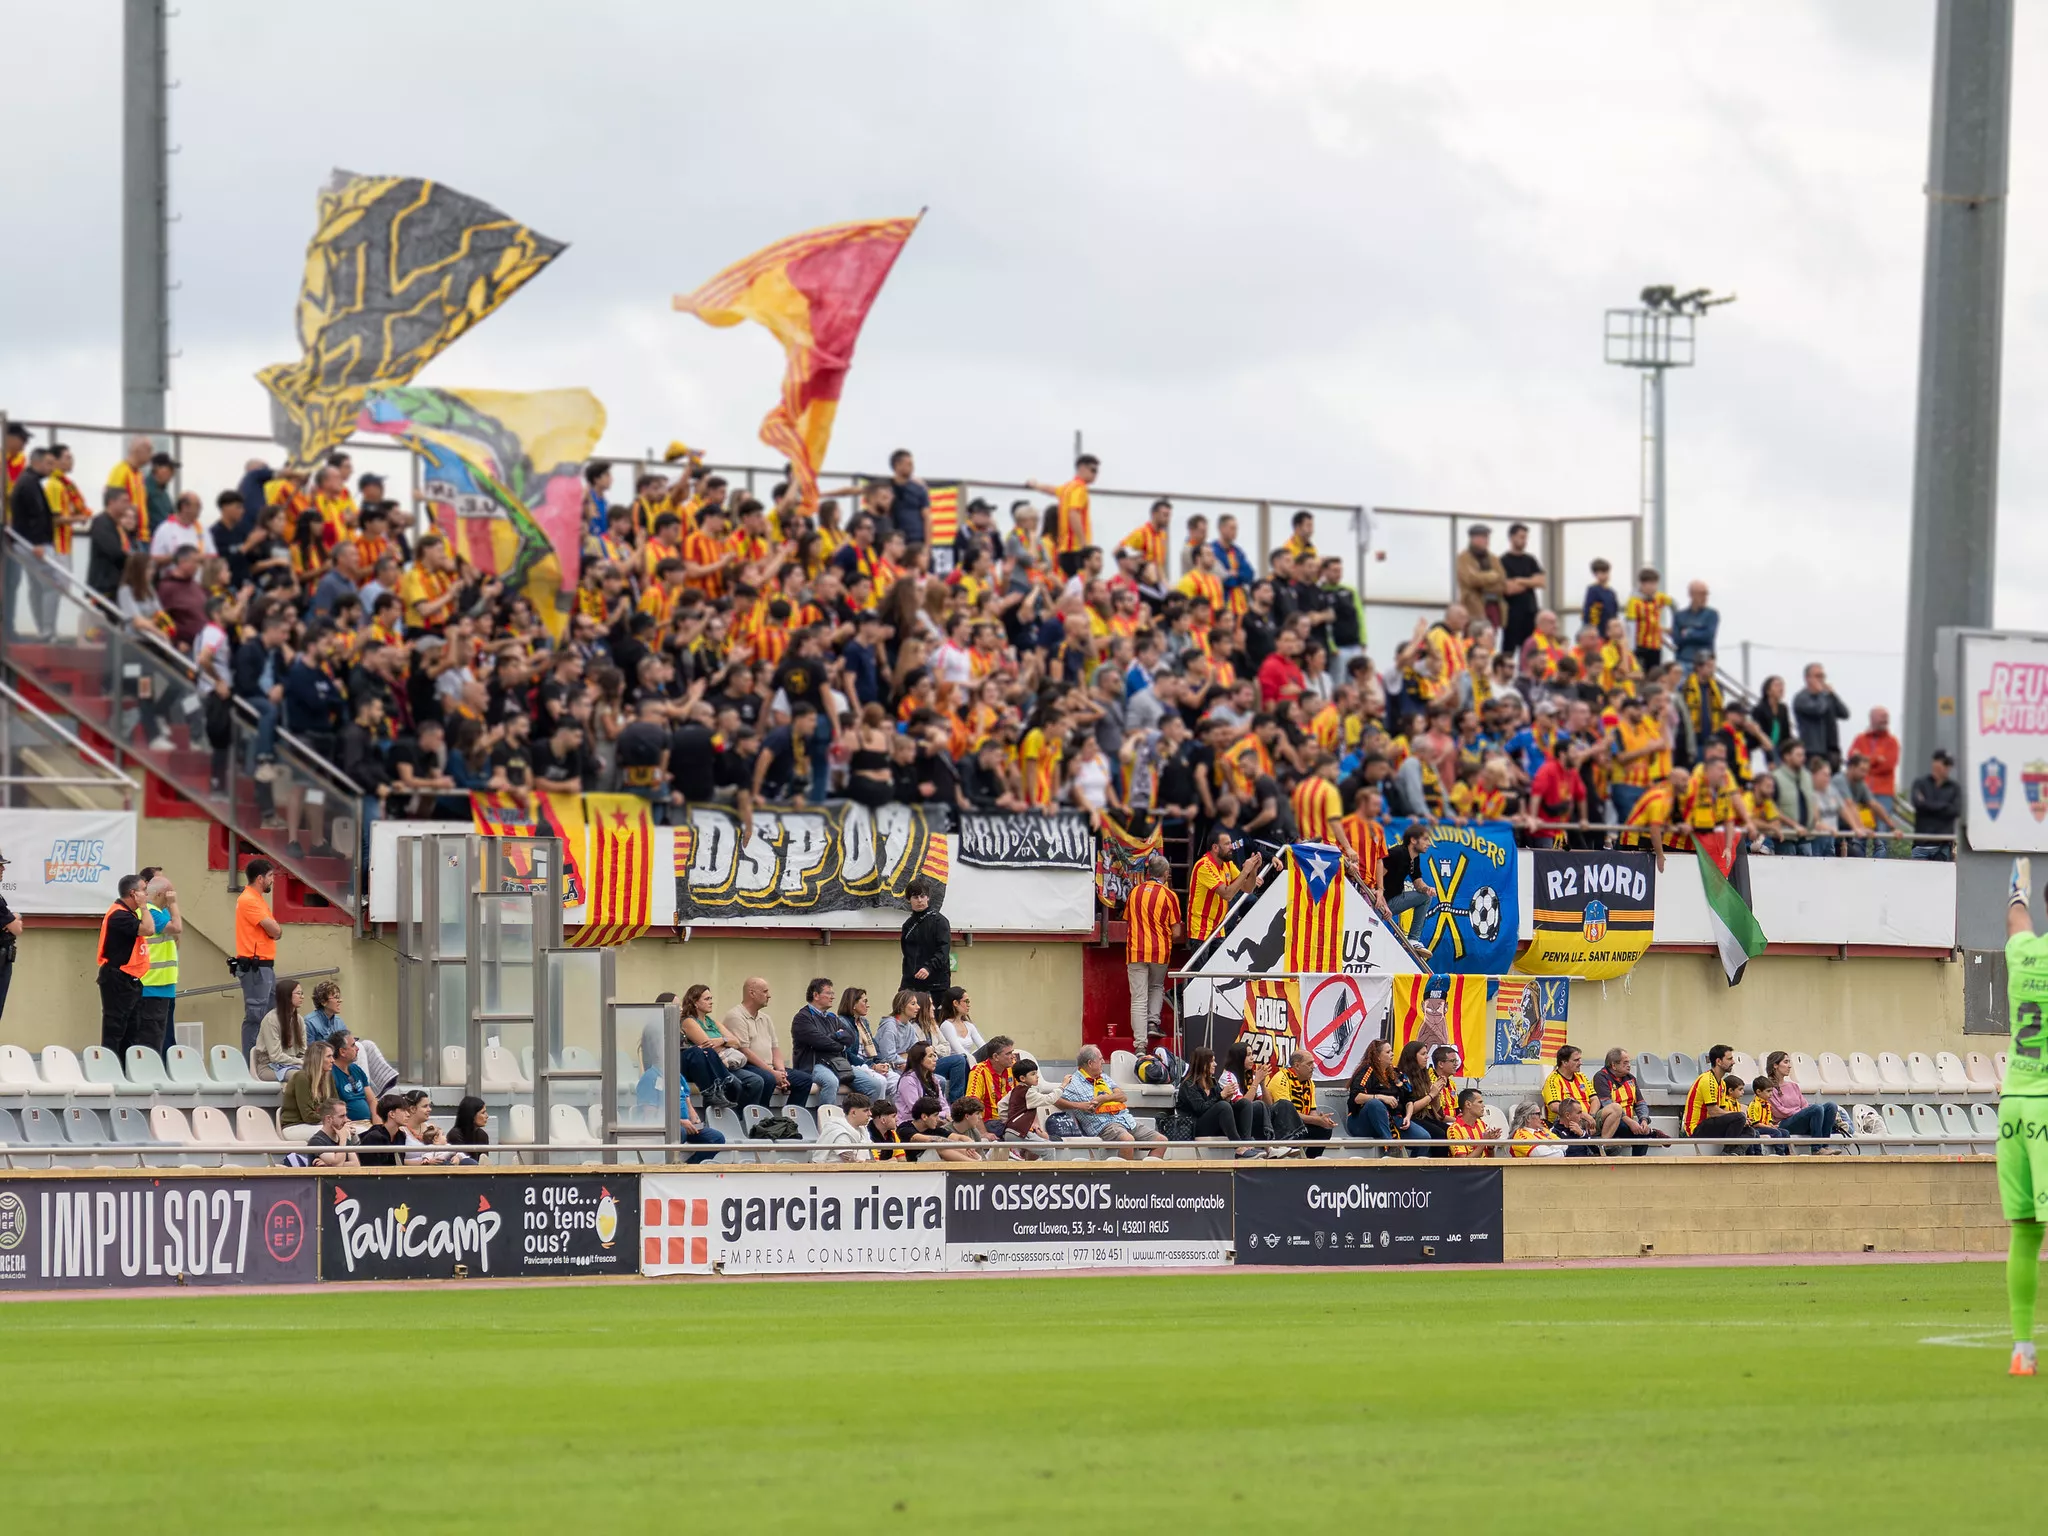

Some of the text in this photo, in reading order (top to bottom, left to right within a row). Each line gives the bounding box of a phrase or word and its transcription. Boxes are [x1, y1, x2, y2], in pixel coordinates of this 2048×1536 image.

[51, 840, 104, 865] REUS
[688, 807, 828, 891] DSP
[56, 865, 101, 881] ESPORT
[1547, 863, 1647, 901] R2 NORD
[2, 883, 17, 891] REUS
[1342, 930, 1373, 963] US
[1542, 951, 1570, 962] PENYA
[1571, 952, 1587, 962] U.E.
[1588, 951, 1611, 962] SANT
[1256, 997, 1287, 1031] BOIG
[524, 1186, 597, 1211] a que...
[955, 1183, 1225, 1213] mr assessors laboral fiscal comptable
[2, 1212, 14, 1220] RF
[274, 1215, 295, 1229] RF
[524, 1206, 595, 1230] no tens
[721, 1185, 942, 1243] garcia riera
[2, 1221, 14, 1230] EF
[41, 1189, 251, 1278] IMPULSO27
[1013, 1221, 1038, 1235] Carrer
[1072, 1221, 1085, 1236] 53,
[1087, 1220, 1097, 1234] 3r
[1102, 1220, 1114, 1234] 4a
[1122, 1220, 1146, 1234] 43201
[274, 1233, 295, 1247] EF
[524, 1230, 571, 1253] ous?
[1446, 1233, 1462, 1243] JAC
[524, 1256, 552, 1266] Pavicamp
[594, 1254, 617, 1263] frescos
[721, 1246, 942, 1265] EMPRESA CONSTRUCTORA
[961, 1248, 1220, 1264] labl@mr-assessors.cat 977 126 451 www.mr-assessors.cat
